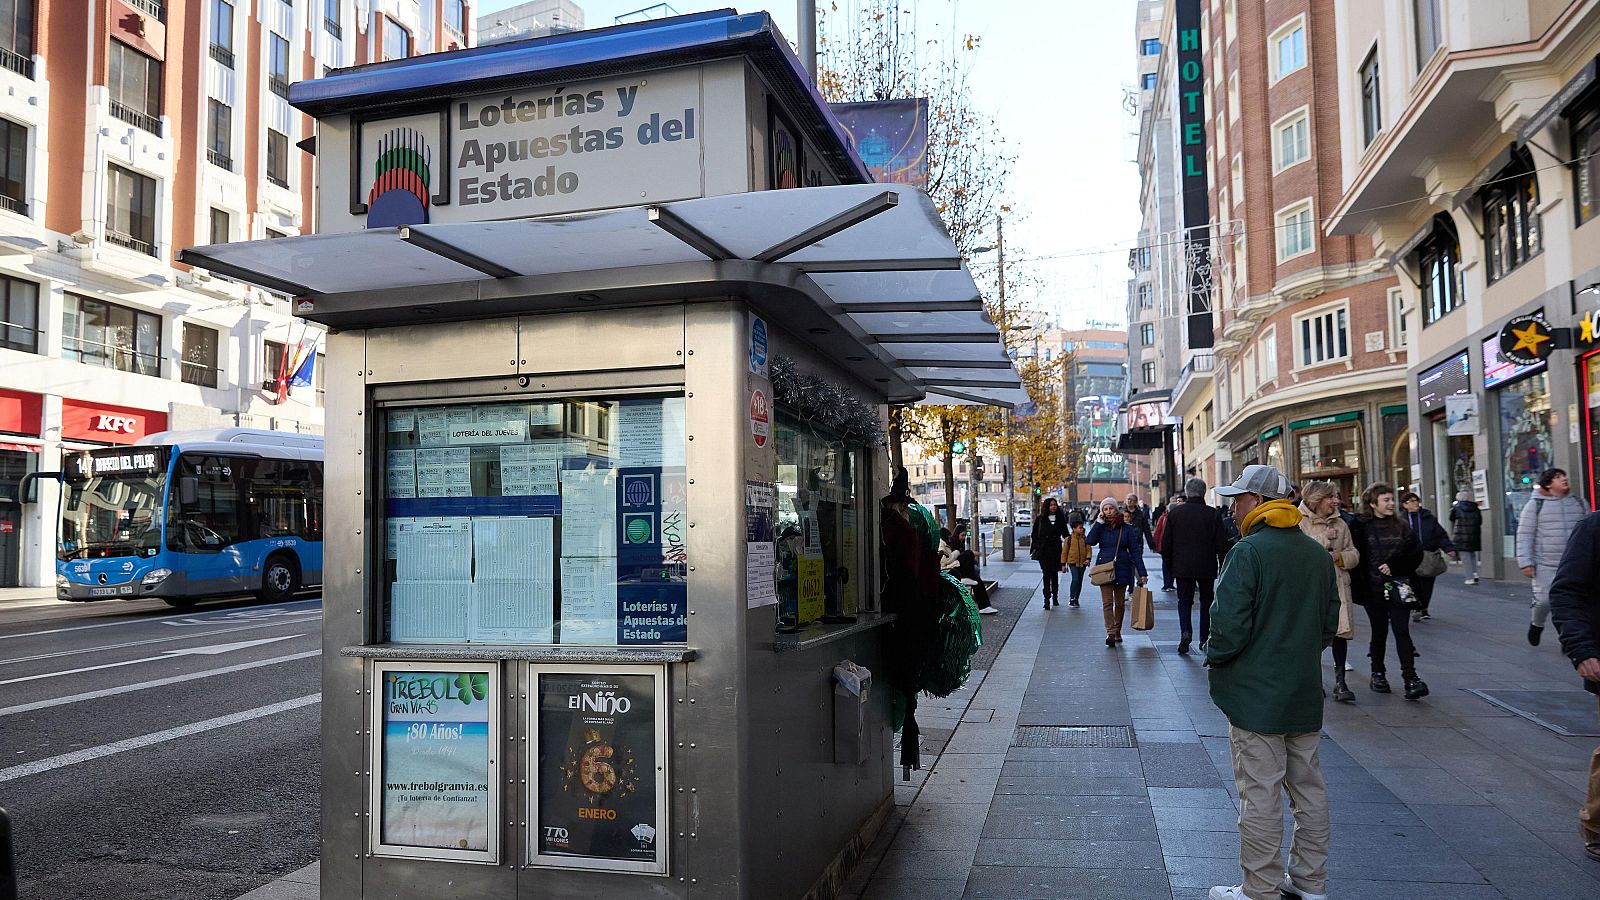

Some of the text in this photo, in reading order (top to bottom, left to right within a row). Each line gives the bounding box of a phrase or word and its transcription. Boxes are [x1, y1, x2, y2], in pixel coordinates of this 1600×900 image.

[459, 84, 638, 130] Loterías y
[1181, 28, 1202, 177] HOTEL
[458, 108, 696, 172] Apuestas del
[458, 166, 580, 206] Estado
[98, 416, 137, 434] KFC
[452, 429, 480, 438] LOTERÍA
[120, 455, 133, 470] DEL
[133, 454, 155, 469] PILAR
[1086, 453, 1122, 462] NAVIDAD
[623, 600, 677, 614] Loterías y
[624, 615, 688, 628] Apuestas de
[624, 628, 661, 640] Estado
[390, 702, 408, 714] GRAN
[582, 691, 631, 715] Niño
[406, 723, 463, 743] ¡80 Años!
[579, 744, 616, 794] 6
[387, 782, 488, 792] www.trebolgranvia.es
[578, 808, 617, 820] ENERO
[544, 826, 569, 838] 770
